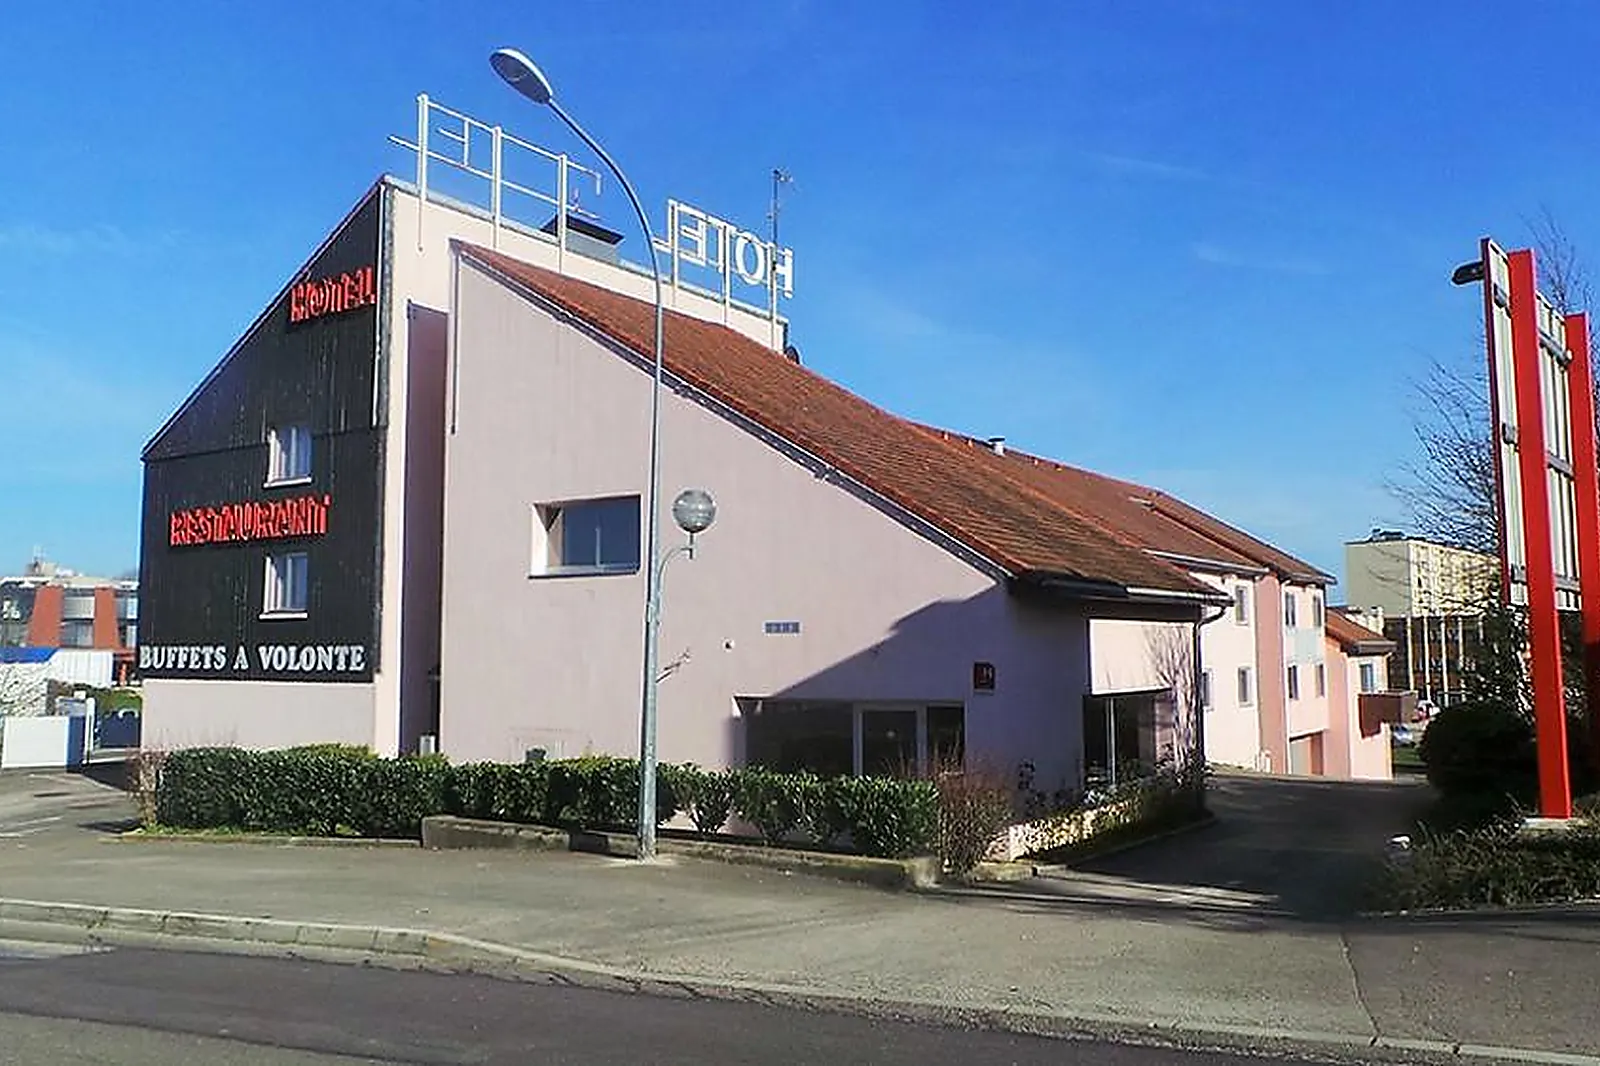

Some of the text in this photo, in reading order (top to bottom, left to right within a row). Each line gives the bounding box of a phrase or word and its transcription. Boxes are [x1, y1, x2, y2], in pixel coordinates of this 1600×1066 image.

[169, 495, 332, 546] RESTAURANT
[139, 645, 227, 670] BUFFETS
[258, 646, 366, 672] VOLONTE
